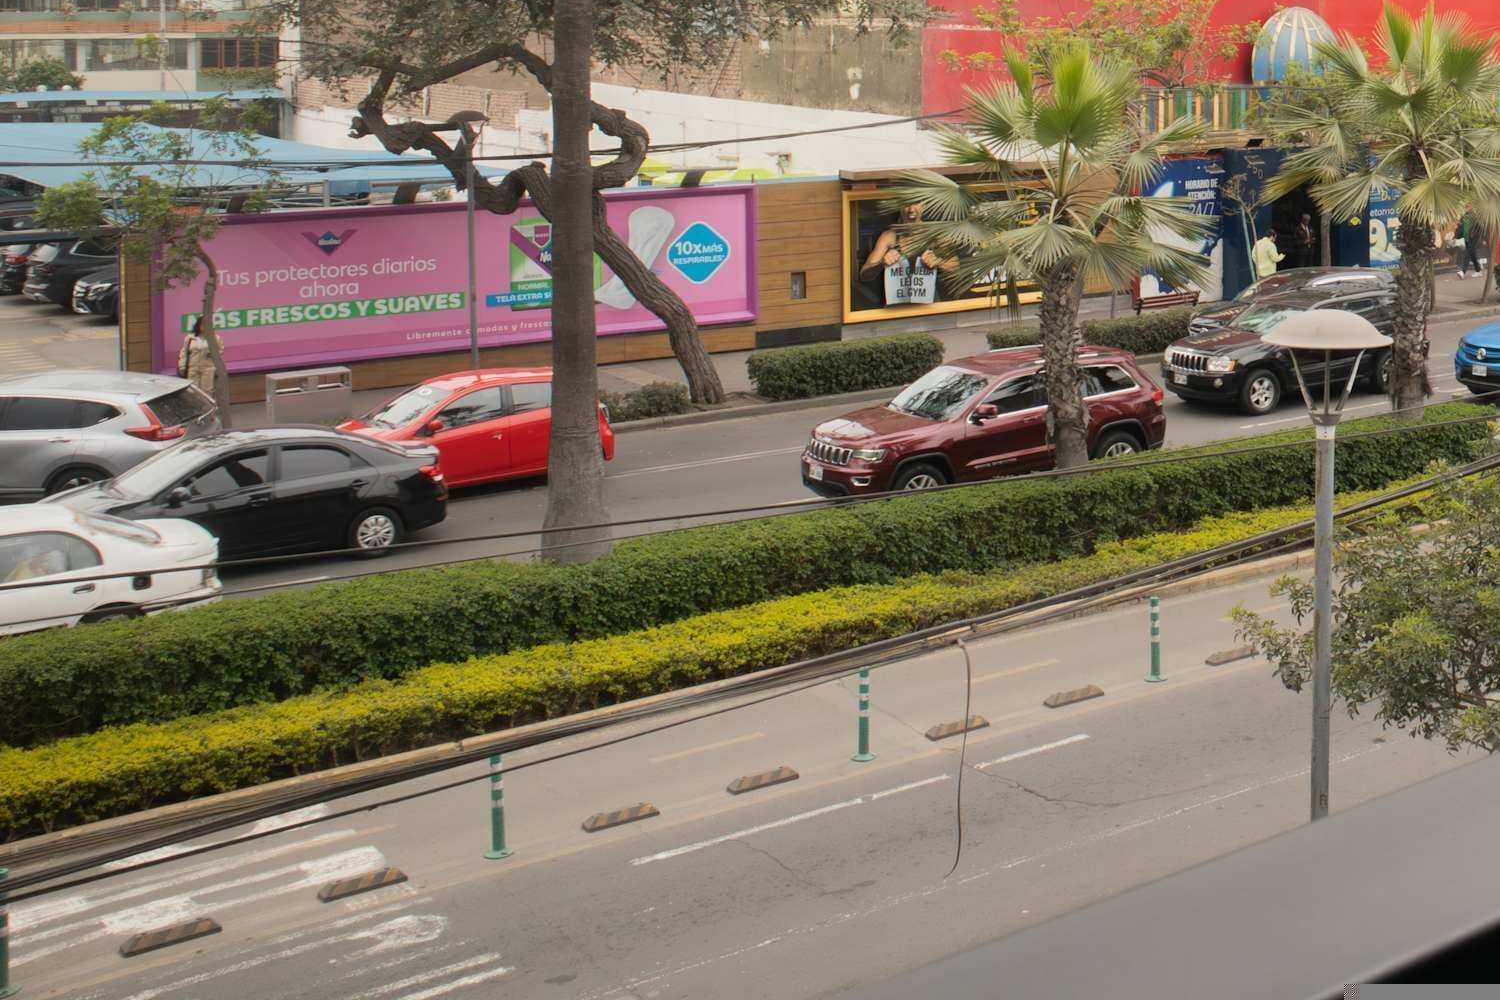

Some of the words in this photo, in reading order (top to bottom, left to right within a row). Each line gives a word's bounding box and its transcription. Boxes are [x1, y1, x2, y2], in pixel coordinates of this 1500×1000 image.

[1210, 178, 1219, 188] DE
[216, 270, 250, 286] Tus
[255, 262, 369, 288] protectores
[372, 256, 437, 275] diarios
[890, 266, 905, 277] ME
[299, 280, 360, 299] ahora
[246, 300, 352, 327] FRESCOS
[355, 301, 372, 317] Y
[374, 292, 463, 316] SUAVES
[406, 328, 463, 341] Libremente
[465, 324, 509, 336] cmodas
